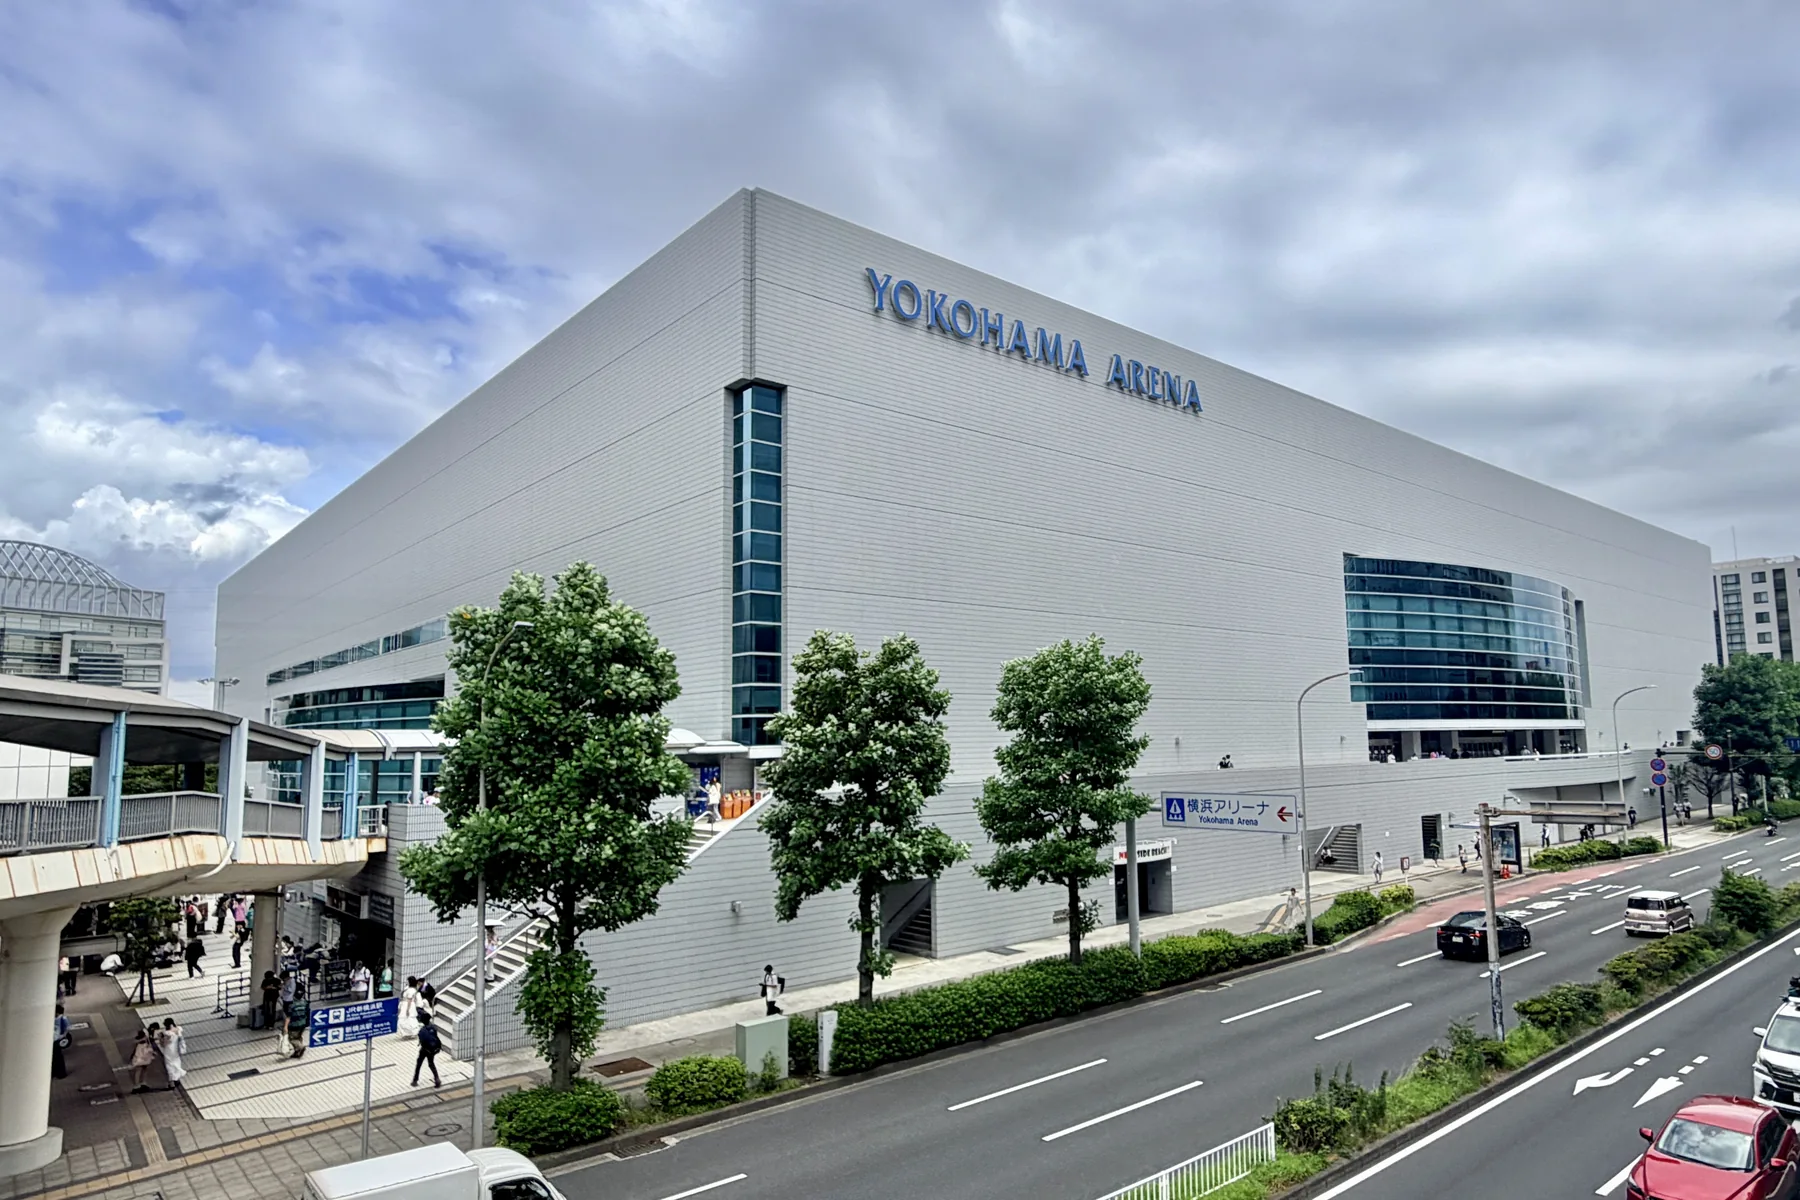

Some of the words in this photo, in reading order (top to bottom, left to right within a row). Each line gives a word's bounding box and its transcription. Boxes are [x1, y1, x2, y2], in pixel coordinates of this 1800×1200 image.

[865, 267, 1089, 377] YOKOHAMA
[1107, 354, 1203, 413] ARENA
[1187, 798, 1269, 816] 横浜アリーナ
[1199, 815, 1234, 825] Yokohama
[1237, 817, 1259, 827] Arena
